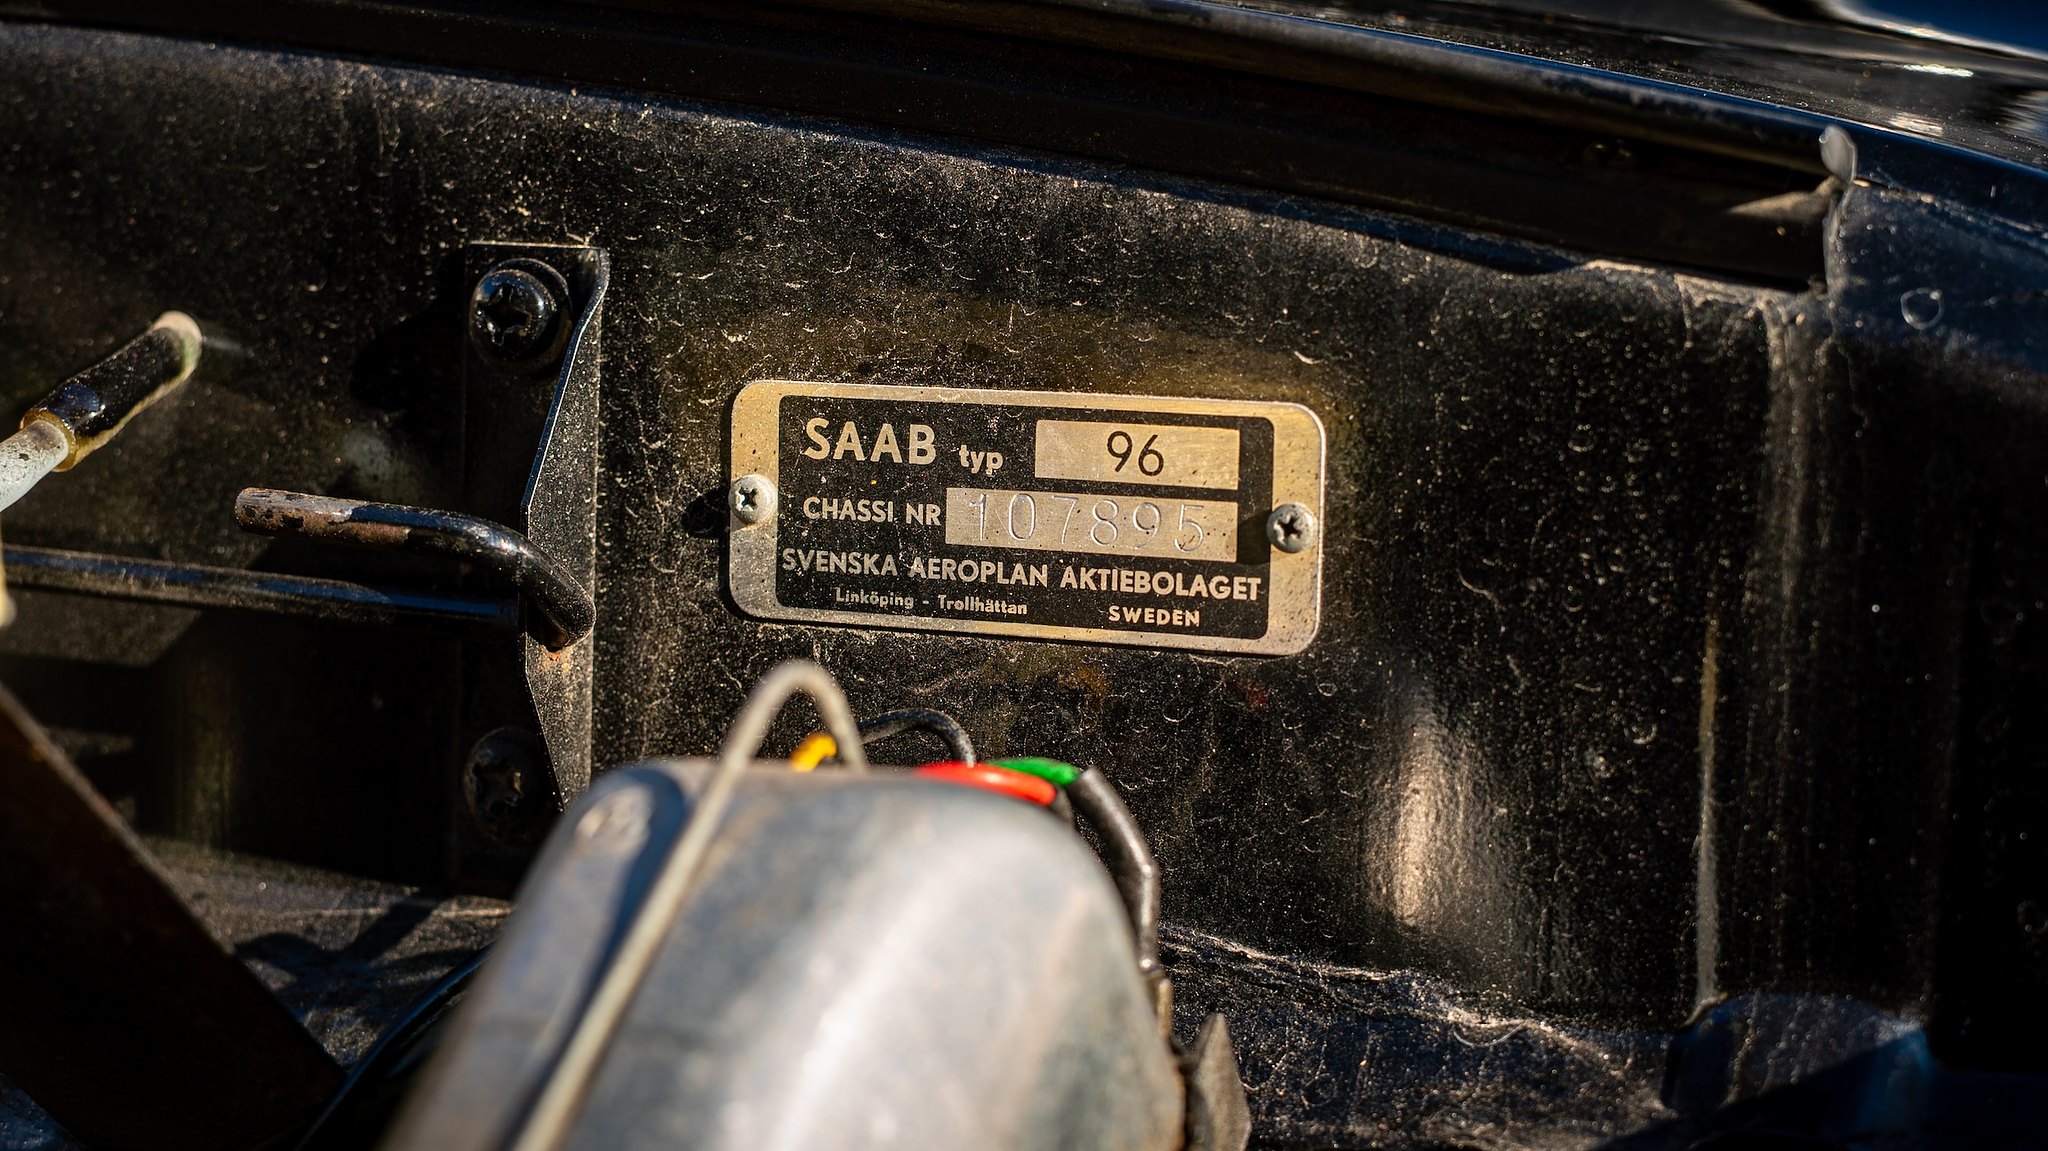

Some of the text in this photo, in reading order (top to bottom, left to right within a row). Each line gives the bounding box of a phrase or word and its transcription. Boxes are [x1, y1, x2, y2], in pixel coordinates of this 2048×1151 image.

[803, 417, 1165, 477] SAAB typ 96
[802, 493, 1206, 552] CHASSI NR 107895
[781, 548, 1262, 601] SVENSKA AEROPLAN AKTIEBOLAGET
[835, 587, 914, 608] Linköping
[937, 594, 1028, 615] Trollhättan
[1108, 604, 1200, 627] SWEDEN
